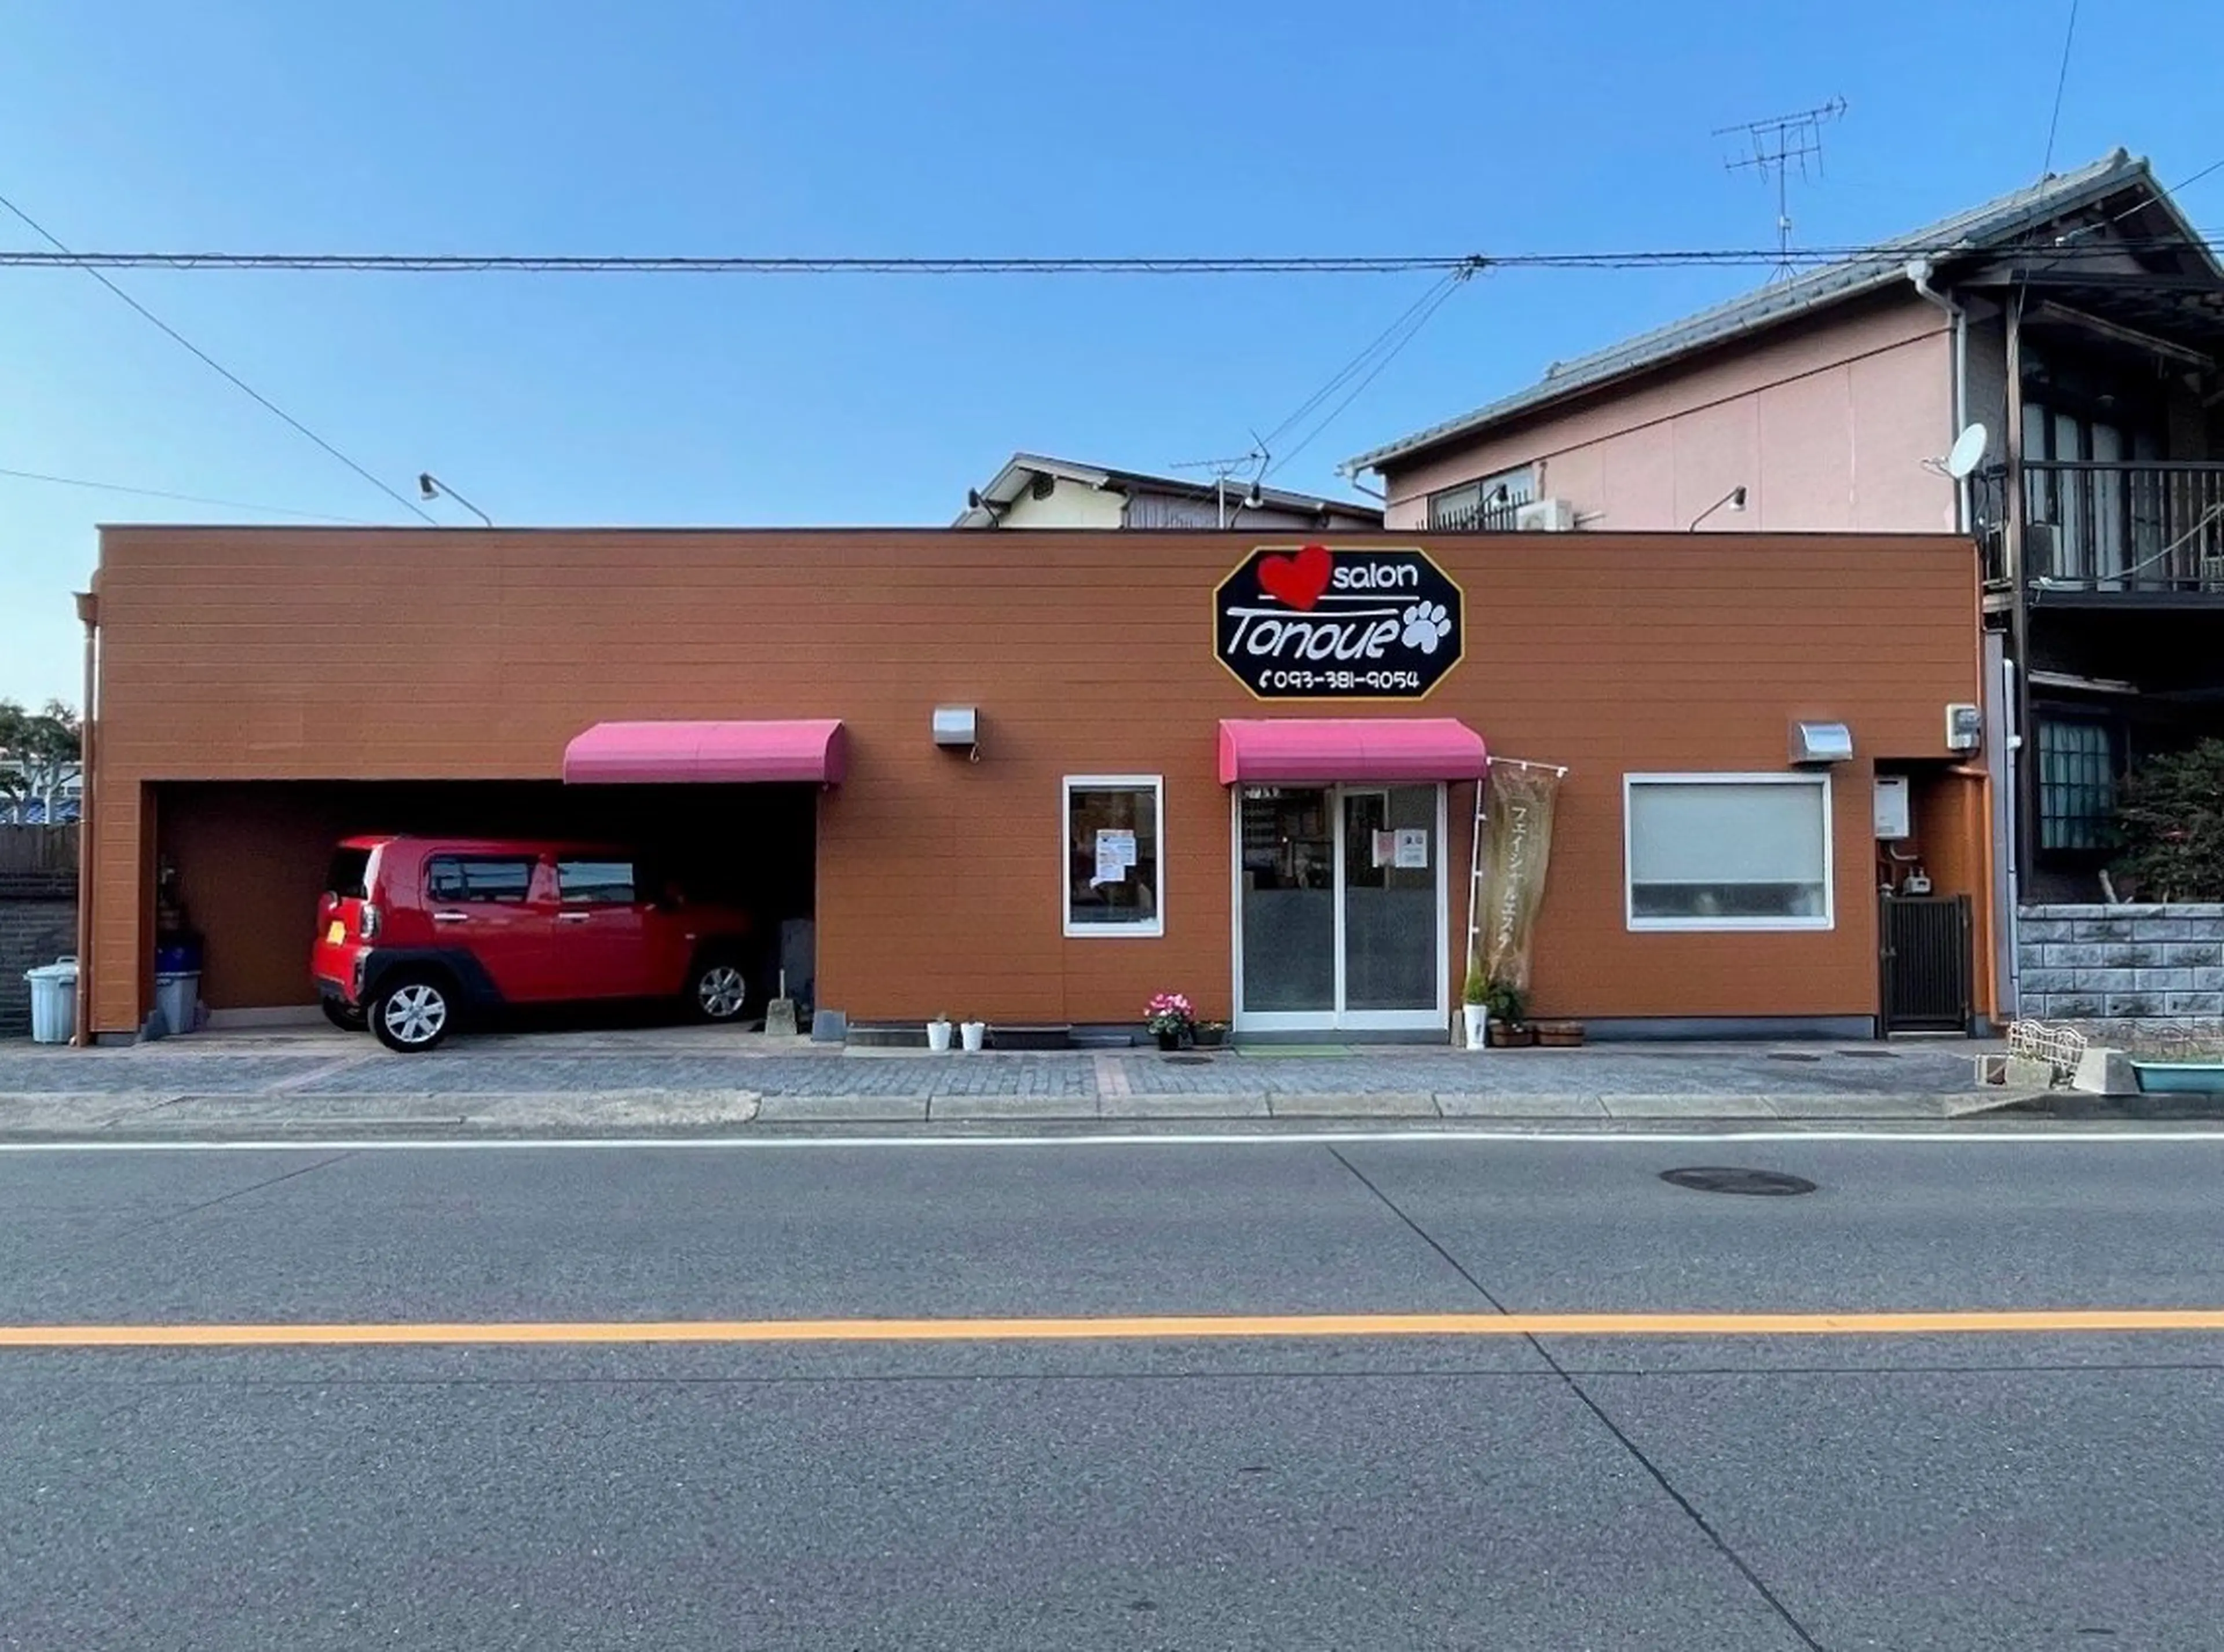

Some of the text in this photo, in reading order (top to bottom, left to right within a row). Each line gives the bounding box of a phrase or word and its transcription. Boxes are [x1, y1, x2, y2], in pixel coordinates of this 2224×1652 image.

[1332, 562, 1418, 589] salon
[1226, 607, 1400, 660] Tonoue
[1274, 671, 1420, 689] 093-381-9054
